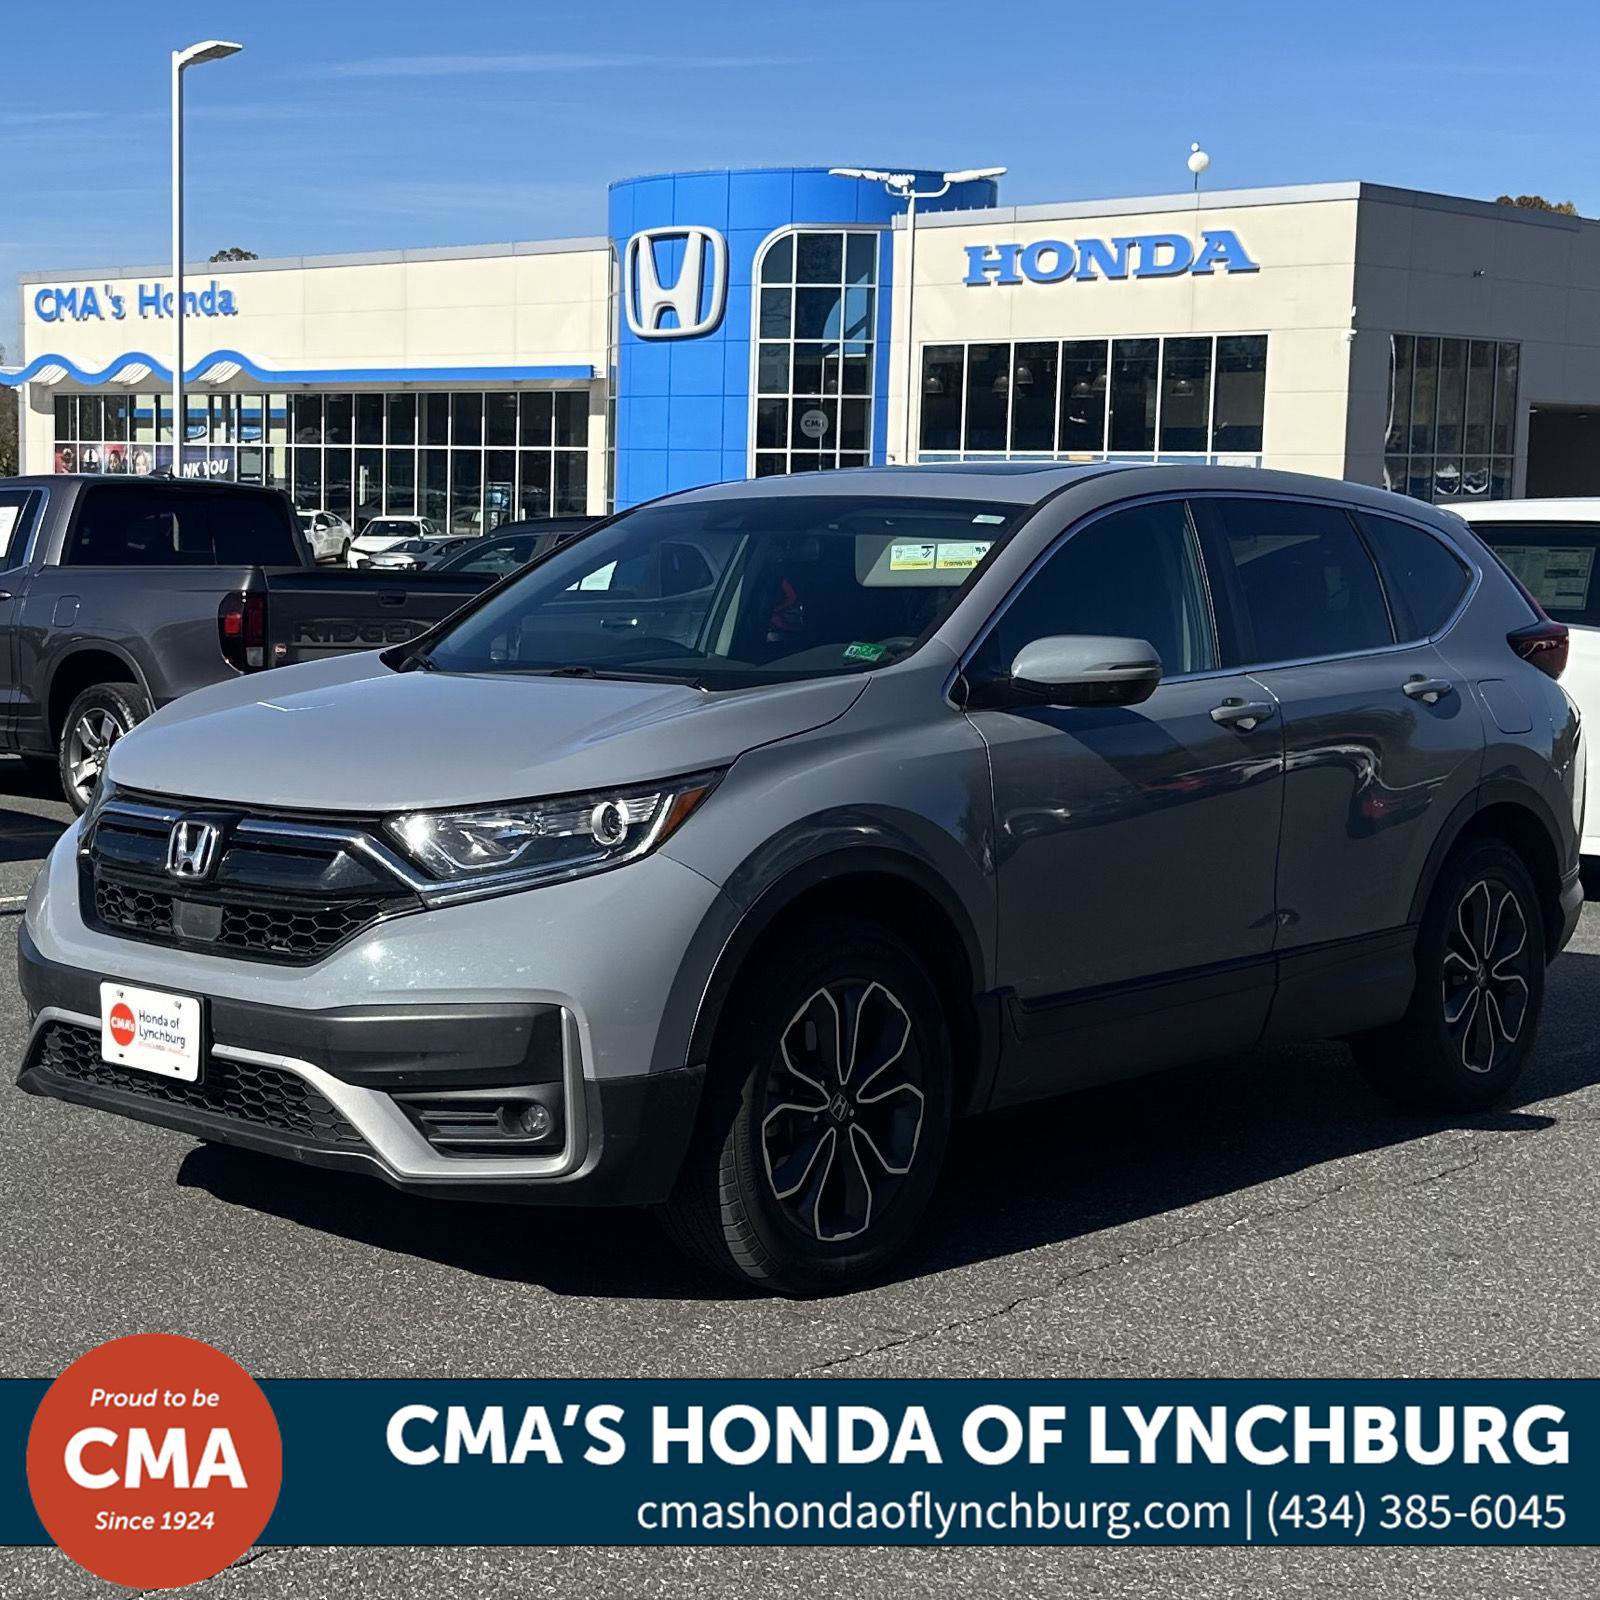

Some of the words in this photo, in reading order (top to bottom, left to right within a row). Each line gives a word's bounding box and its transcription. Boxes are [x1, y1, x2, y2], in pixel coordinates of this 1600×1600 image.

[963, 230, 1260, 287] HONDA
[34, 284, 126, 322] CMA's
[138, 280, 238, 319] Honda
[202, 459, 229, 476] YOU
[294, 622, 412, 644] RIDGE
[139, 1009, 169, 1027] Honda
[170, 1018, 180, 1030] of
[139, 1025, 186, 1049] Lynchburg
